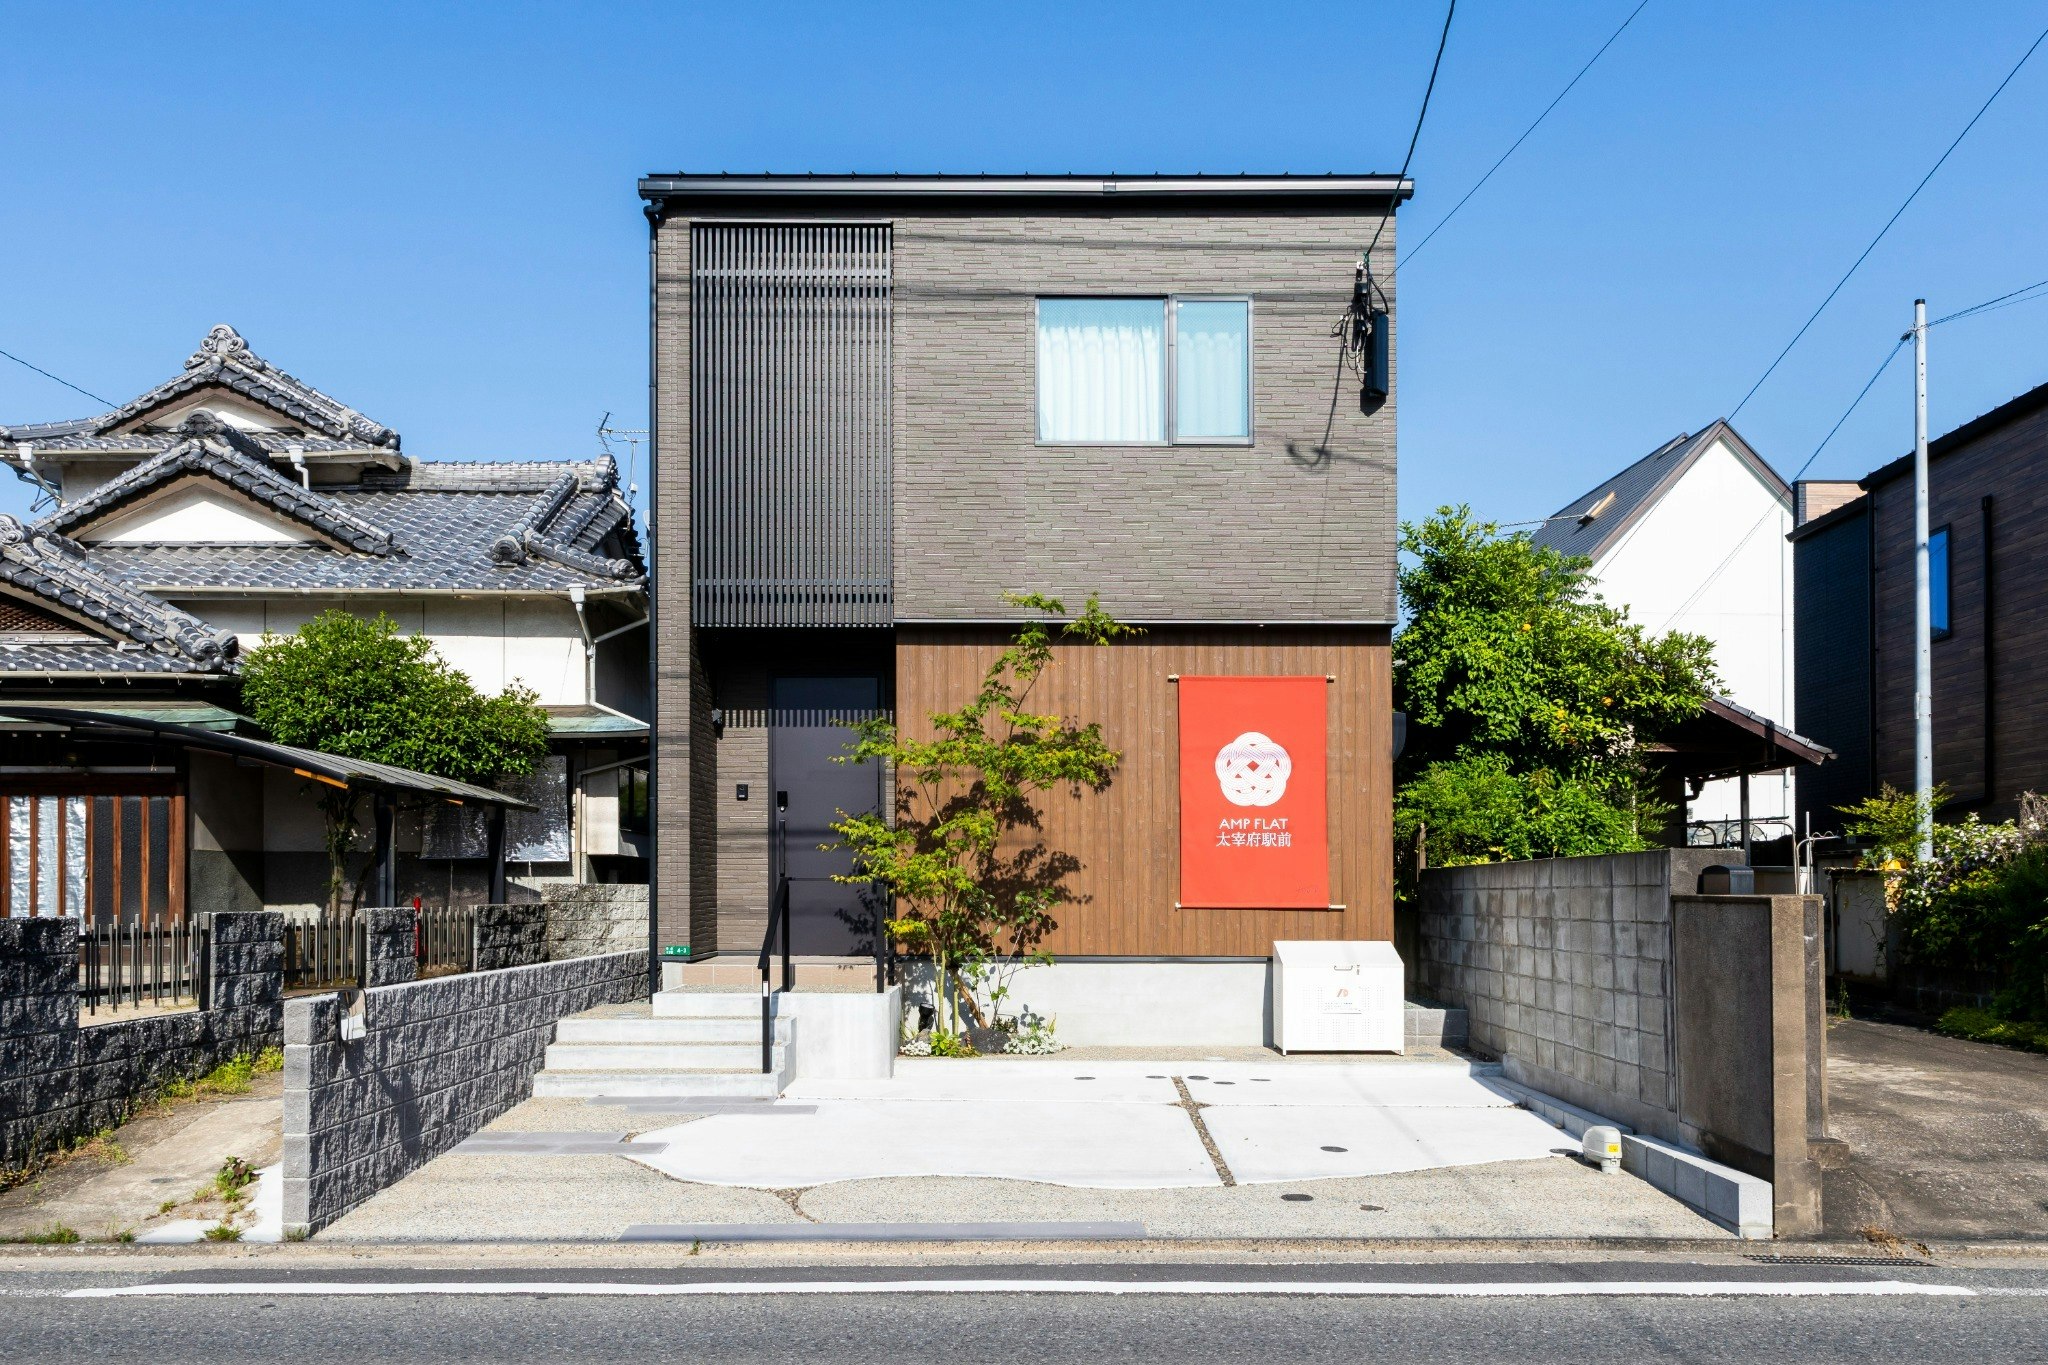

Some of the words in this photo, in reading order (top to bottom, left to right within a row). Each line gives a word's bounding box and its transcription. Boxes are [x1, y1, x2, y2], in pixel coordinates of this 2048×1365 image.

[1219, 818, 1251, 830] AMP
[1254, 818, 1289, 830] FLAT
[1216, 832, 1292, 847] 太宰府駅前
